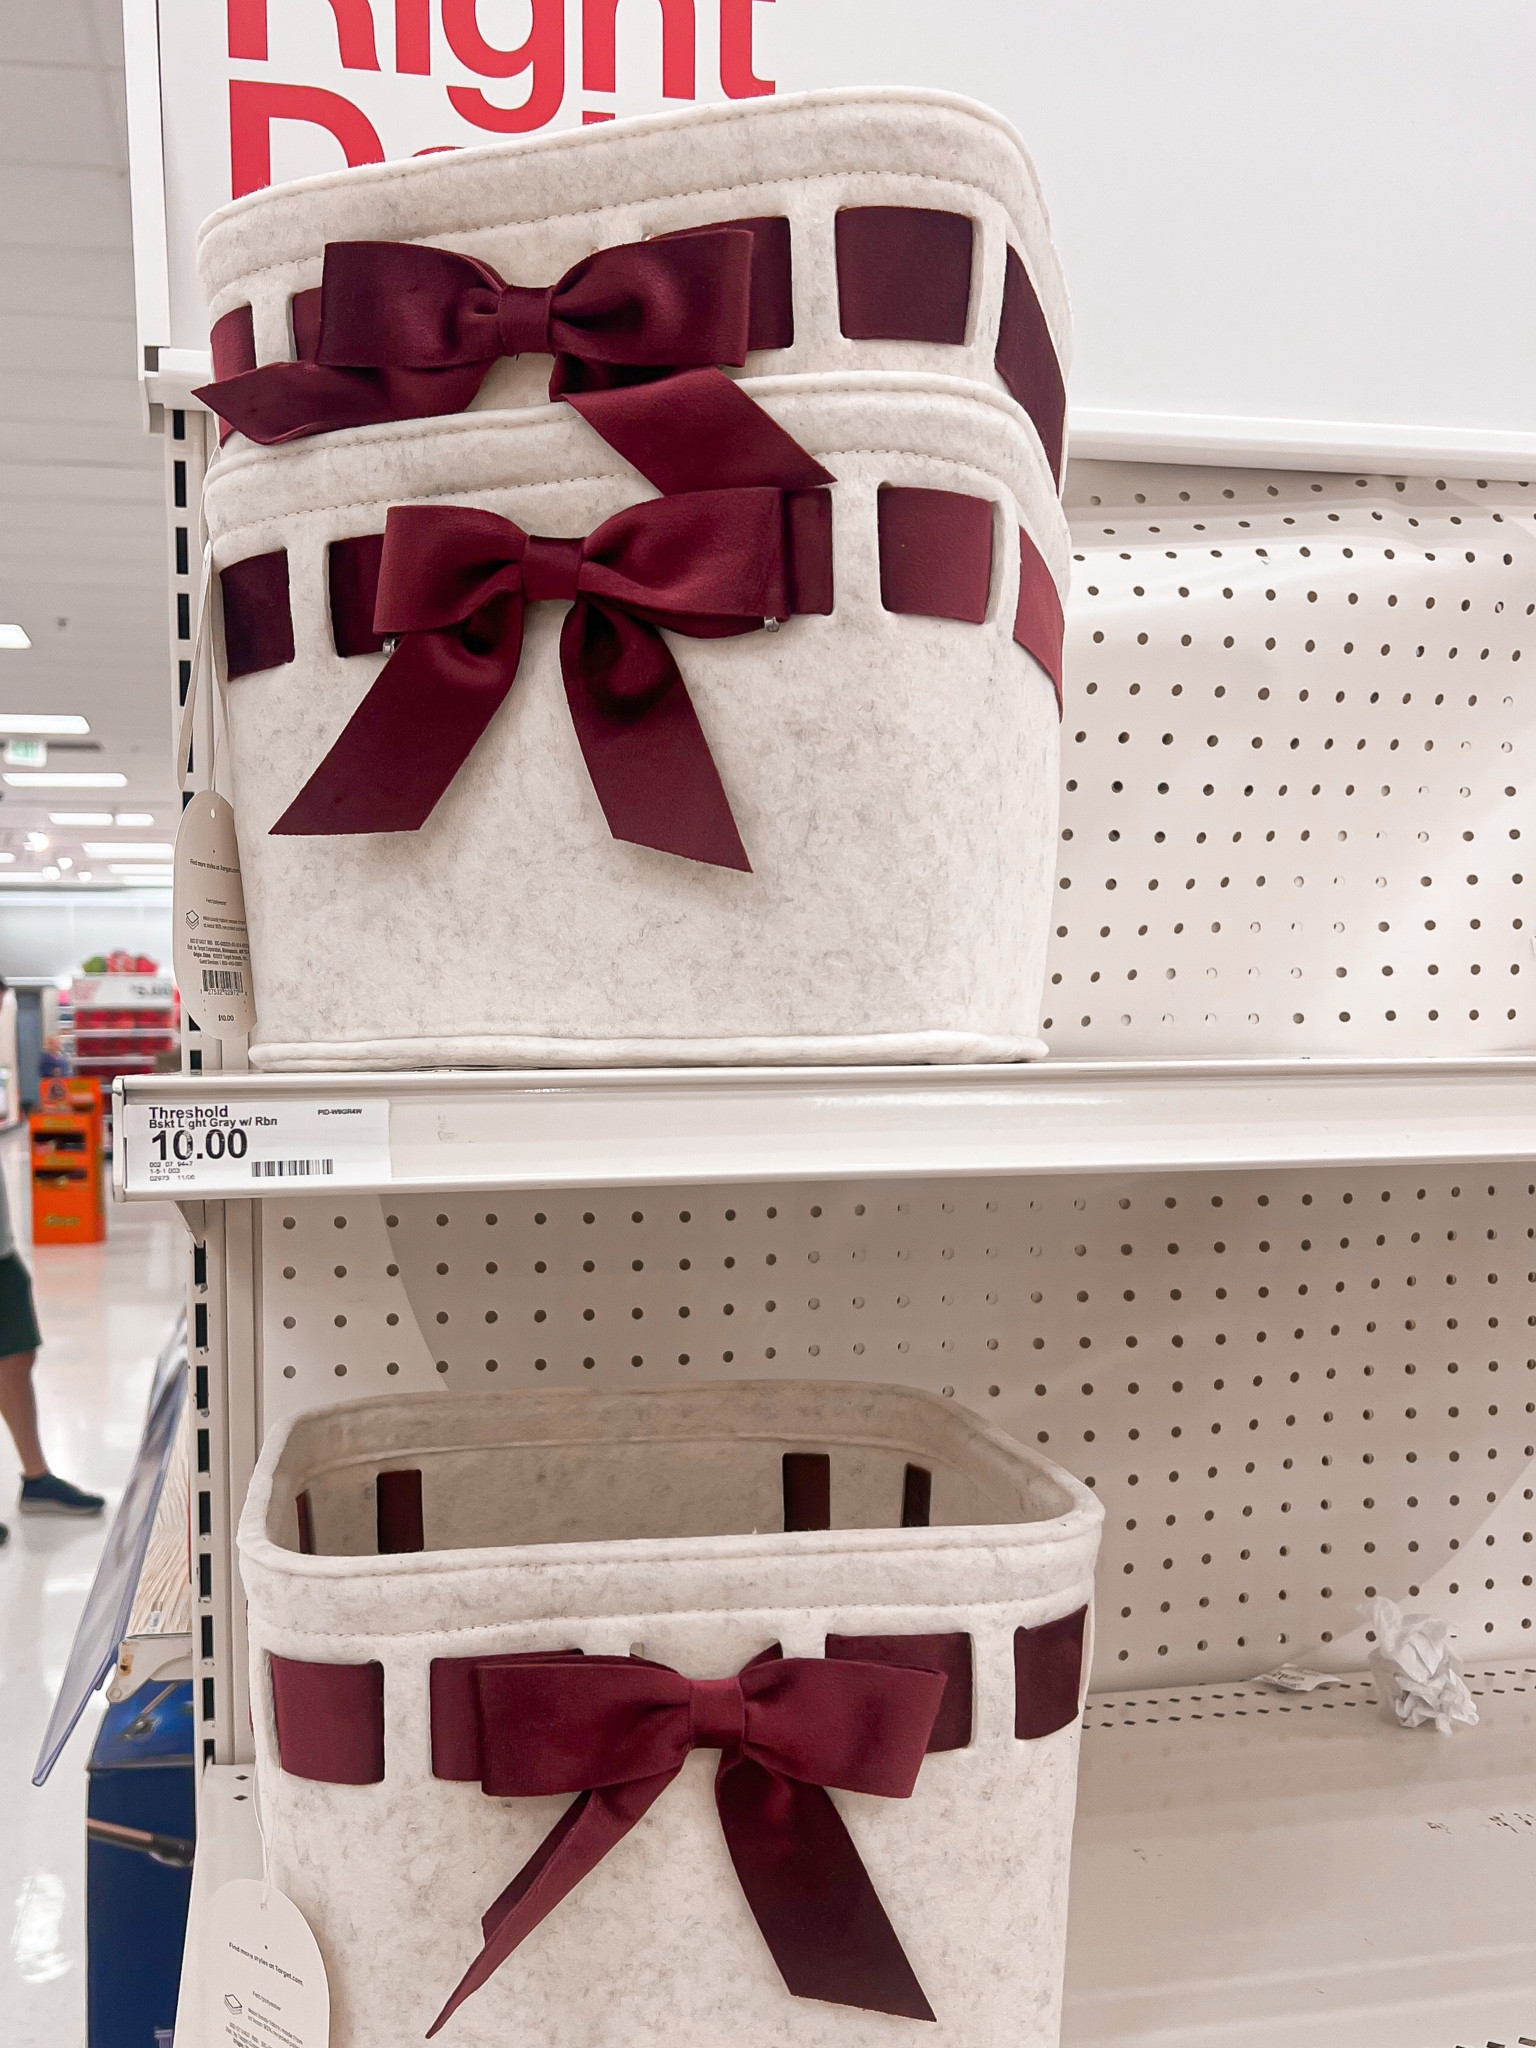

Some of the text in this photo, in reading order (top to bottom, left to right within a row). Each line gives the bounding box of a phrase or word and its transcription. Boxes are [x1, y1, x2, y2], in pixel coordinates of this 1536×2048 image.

[149, 1105, 228, 1119] Threshold
[149, 1119, 175, 1129] Bskt
[209, 1118, 236, 1129] Gray
[239, 1117, 252, 1127] w/
[255, 1116, 278, 1126] Rbn
[152, 1128, 248, 1160] 10.00
